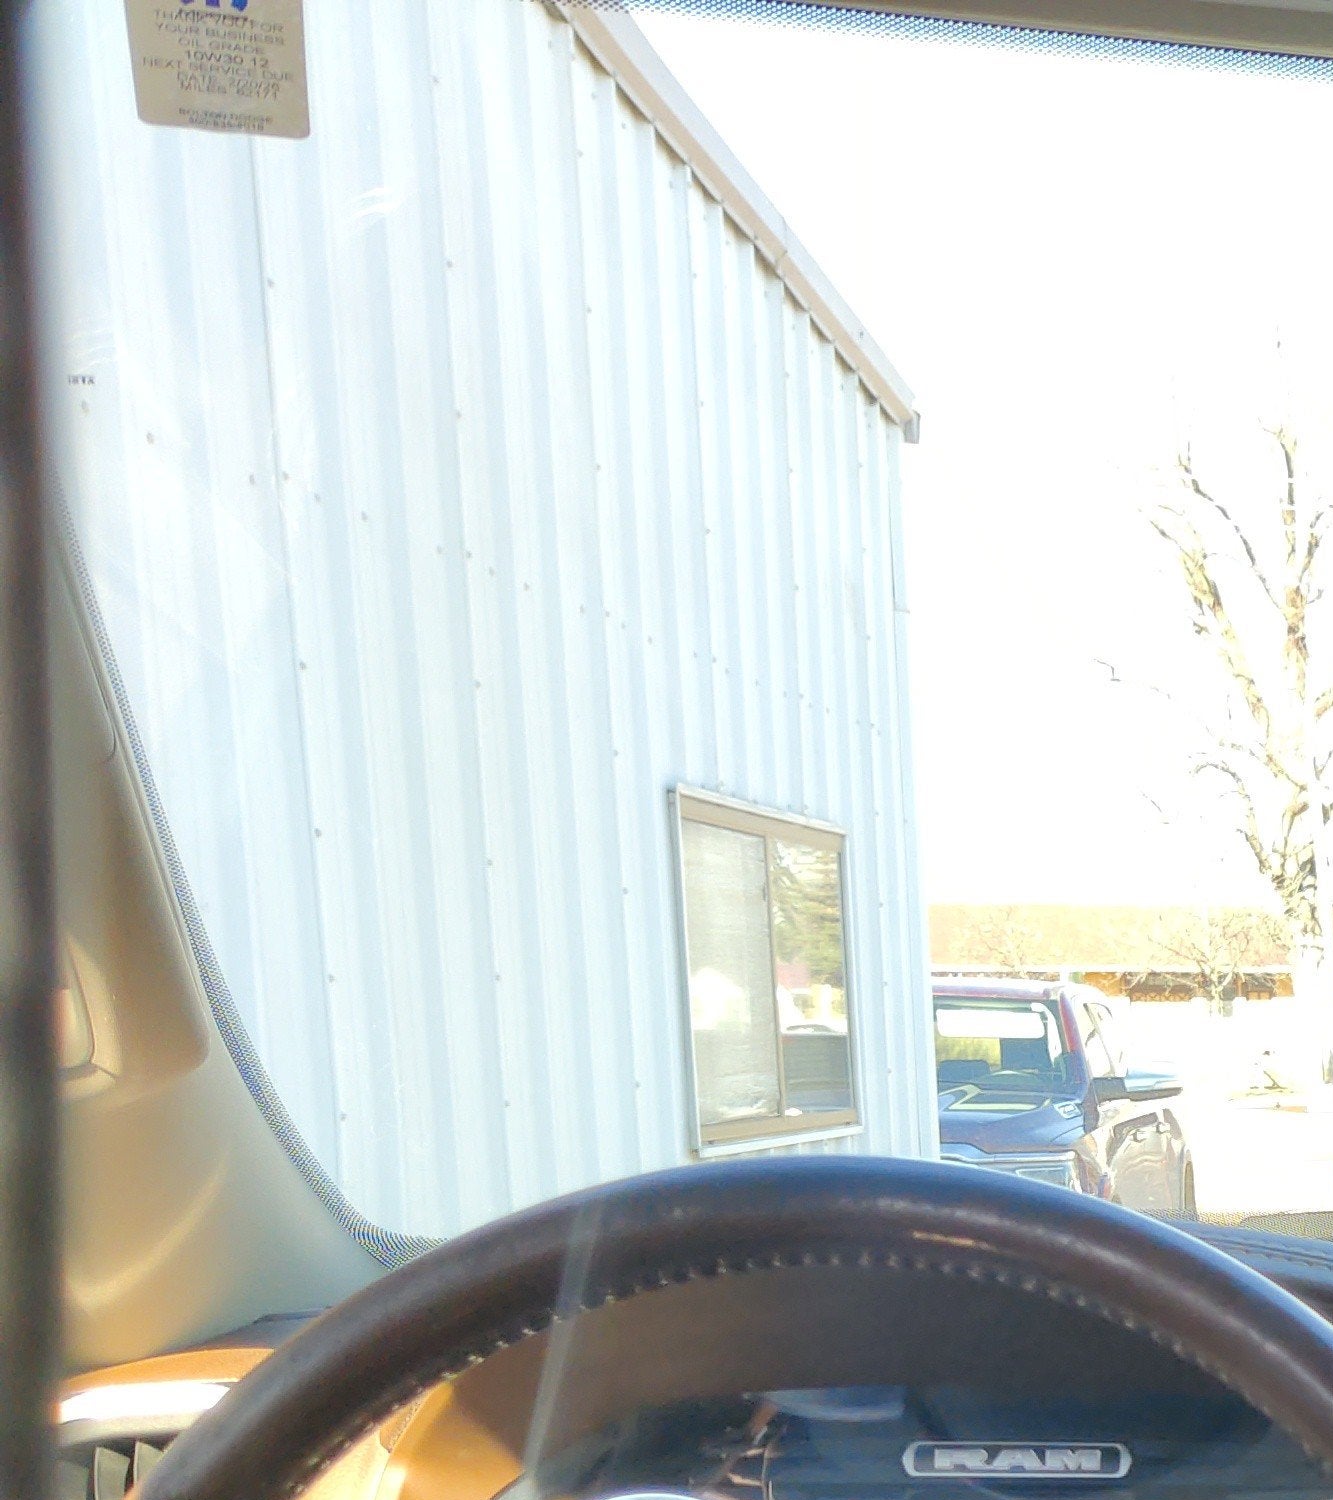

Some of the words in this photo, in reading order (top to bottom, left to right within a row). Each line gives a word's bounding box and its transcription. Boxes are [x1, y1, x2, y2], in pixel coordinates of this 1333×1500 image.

[155, 22, 200, 35] YOUR
[178, 37, 203, 48] OIL
[934, 1449, 1102, 1471] RAM
